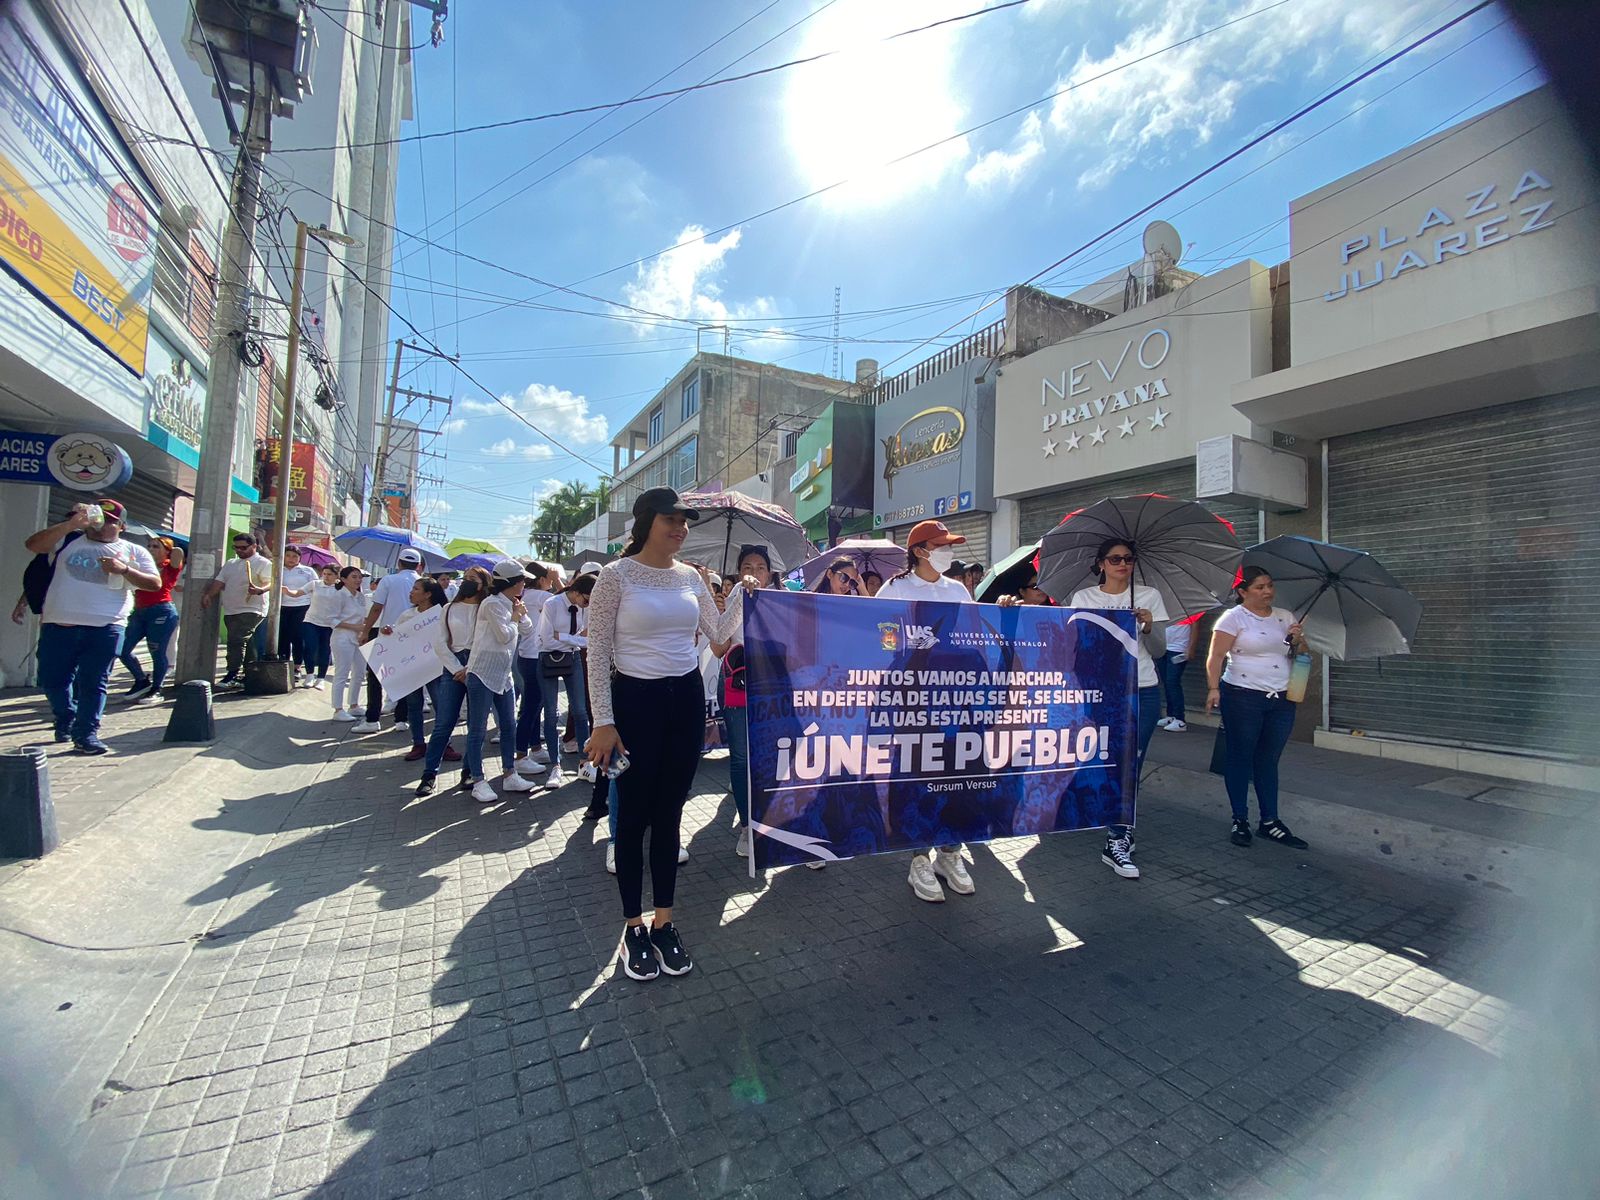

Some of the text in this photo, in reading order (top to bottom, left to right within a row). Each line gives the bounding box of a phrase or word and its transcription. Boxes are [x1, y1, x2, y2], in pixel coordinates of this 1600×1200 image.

[1340, 169, 1553, 265] PLAZA
[1324, 200, 1556, 301] JUAREZ
[72, 269, 126, 333] BEST
[1042, 328, 1170, 406] NEVO
[1042, 378, 1171, 433] PRAVANA
[0, 456, 40, 473] ARES
[905, 625, 934, 639] UAS
[949, 632, 1005, 640] UNIVERSIDAD
[374, 643, 388, 655] 2
[950, 638, 996, 646] AUTÓNOMA
[1014, 640, 1047, 648] SINALOA
[380, 665, 396, 680] No
[847, 669, 1067, 688] JUNTOS VAMOS A MARCHAR,
[793, 689, 1103, 707] EN DEFENSA DE LA UAS SE VE, SE SIENTE:
[870, 709, 1048, 727] LA UAS ESTA PRESENTE
[776, 721, 1110, 781] ¡ÚNETE PUEBLO!
[927, 780, 997, 793] Sursum Versus
